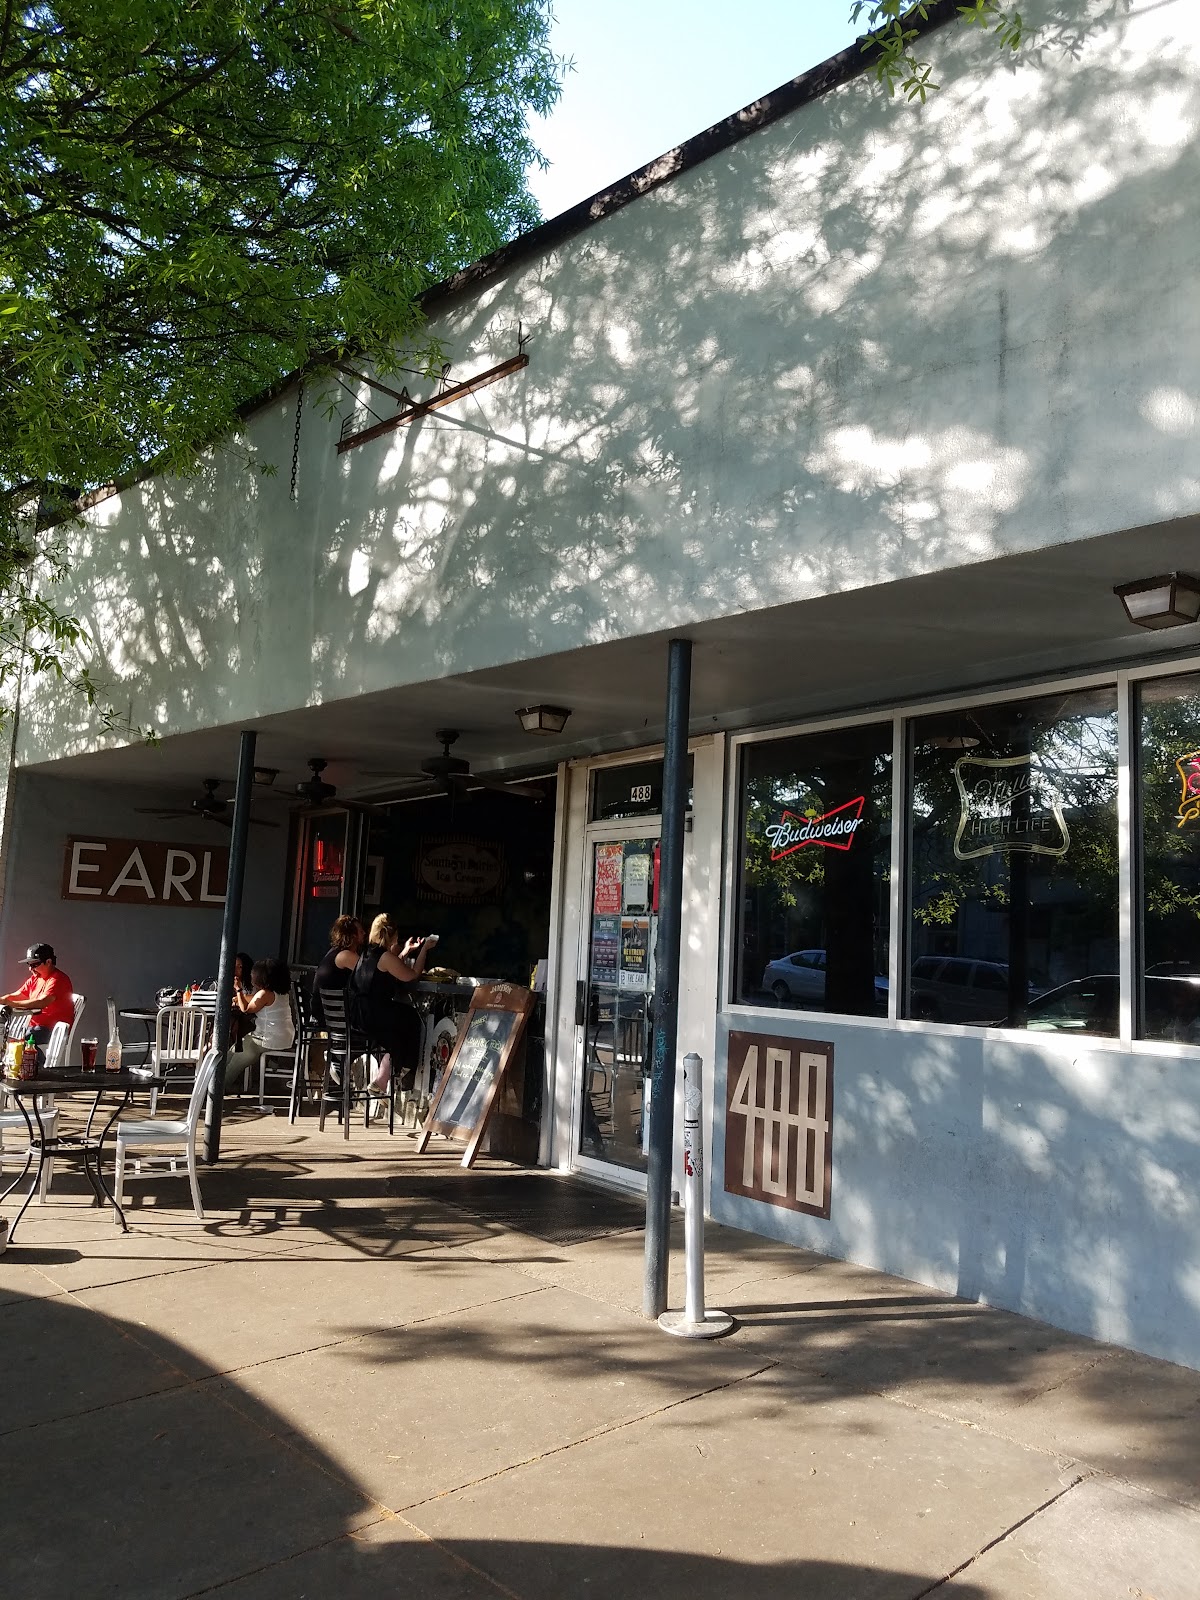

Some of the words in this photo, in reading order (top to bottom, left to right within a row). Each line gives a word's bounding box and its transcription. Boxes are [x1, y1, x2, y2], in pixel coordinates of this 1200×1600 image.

[632, 786, 650, 801] 488
[974, 774, 1038, 803] Mille
[765, 816, 864, 848] Budweiser
[971, 820, 1010, 836] HIGH
[1012, 816, 1052, 834] LIFE
[69, 841, 227, 903] EARL
[437, 870, 449, 881] Ice
[455, 871, 485, 883] Cream
[635, 973, 645, 983] EARL
